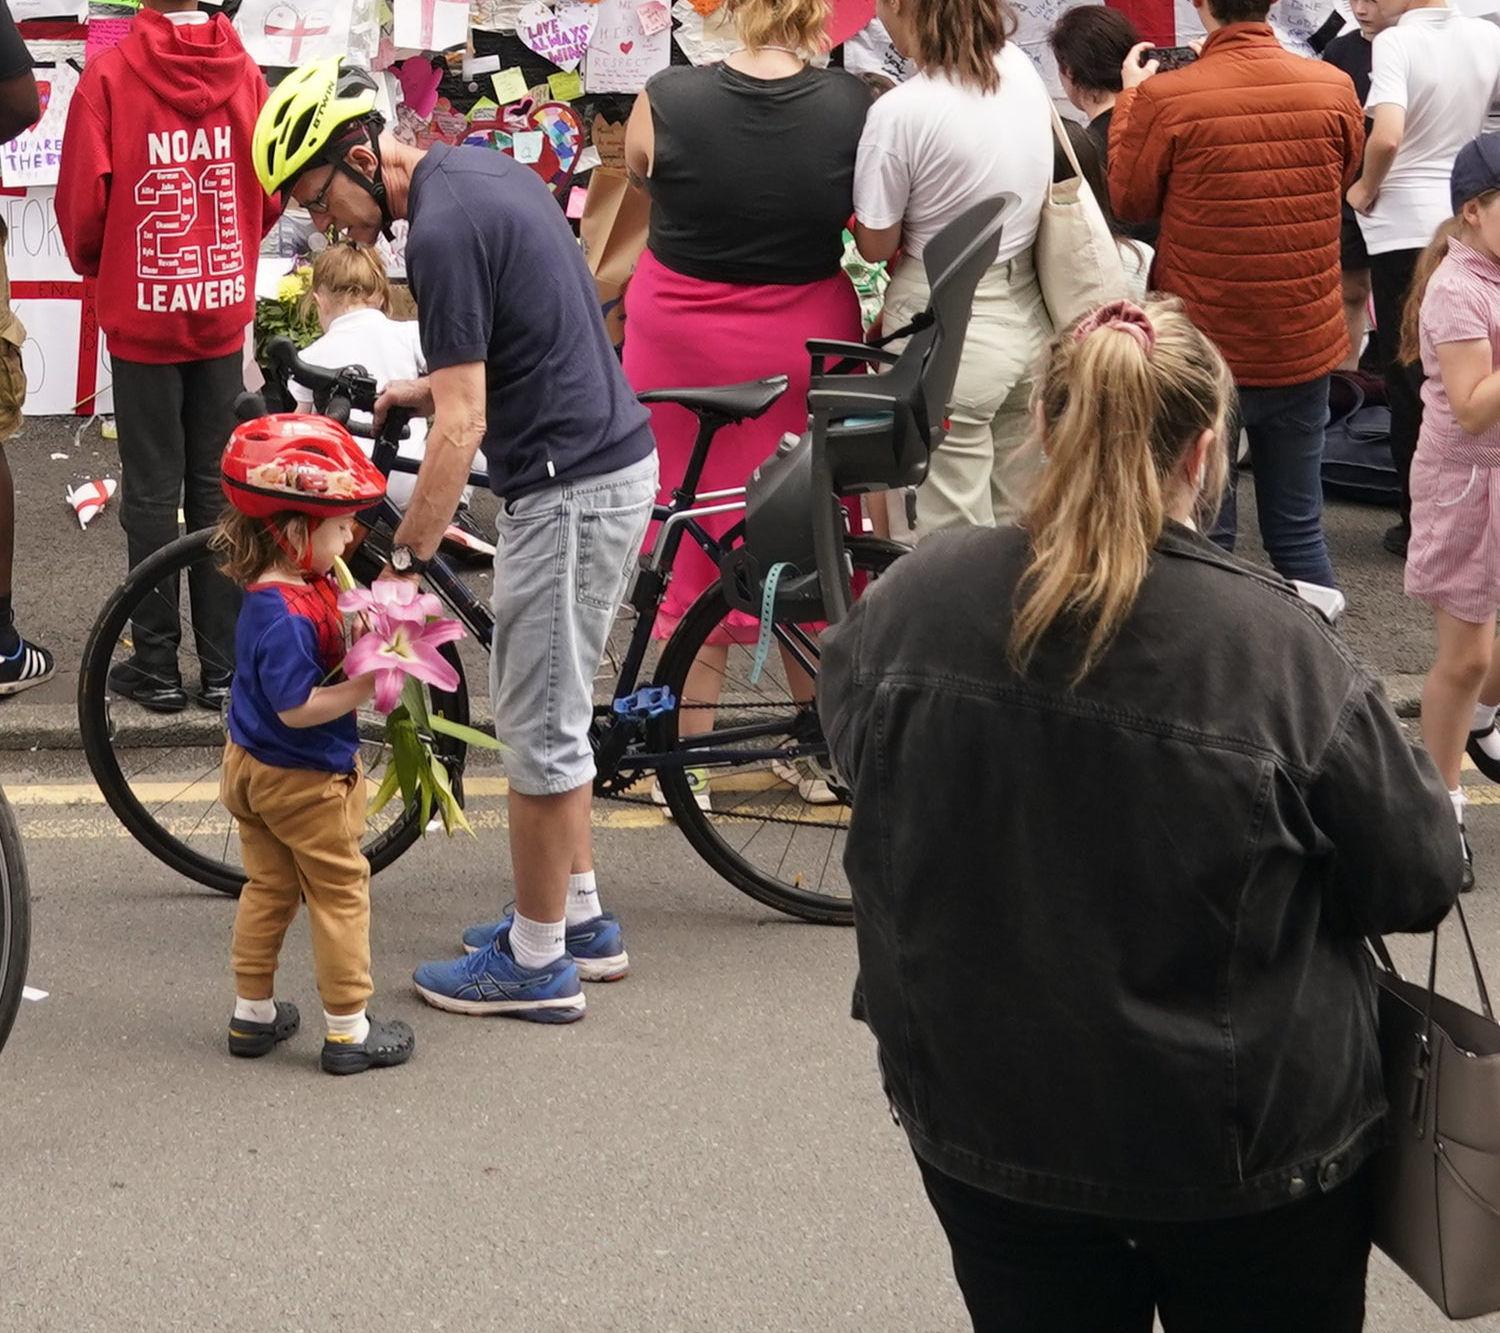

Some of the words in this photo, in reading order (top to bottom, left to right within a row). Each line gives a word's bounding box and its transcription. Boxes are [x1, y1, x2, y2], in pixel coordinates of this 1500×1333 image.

[527, 18, 558, 38] LOVE
[531, 25, 590, 53] ALWAYS
[548, 43, 588, 64] WINS
[148, 126, 231, 165] NOAH
[135, 162, 244, 279] 21
[137, 275, 246, 312] LEAVERS
